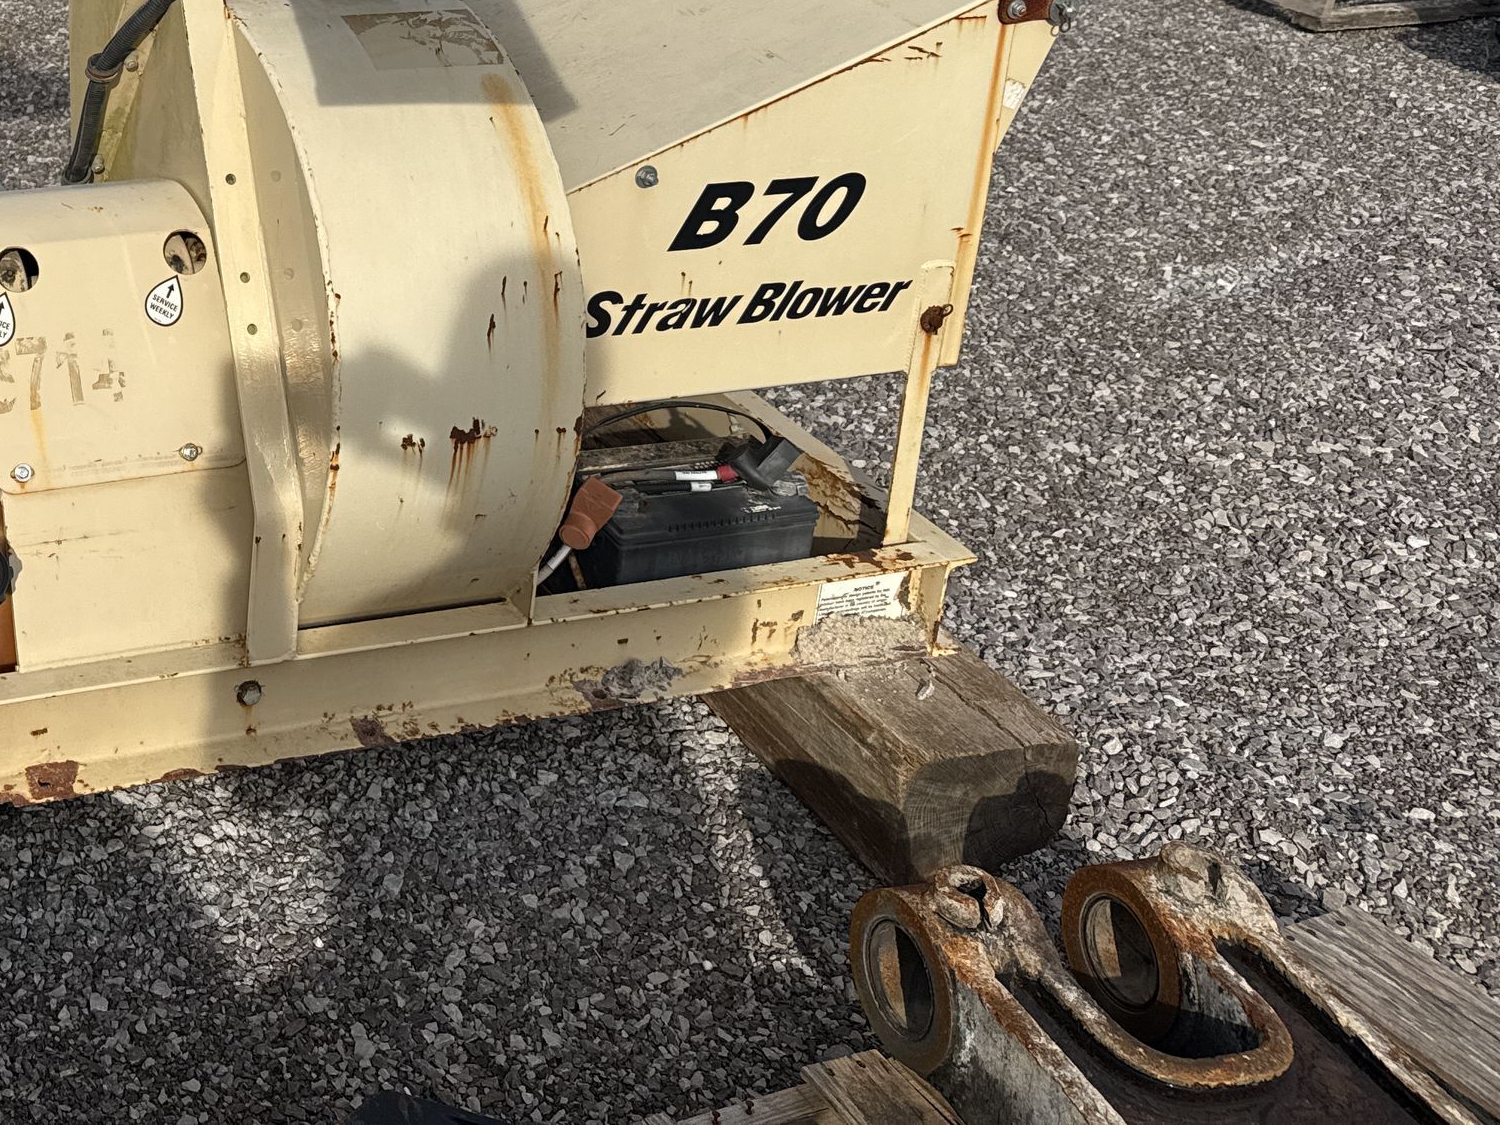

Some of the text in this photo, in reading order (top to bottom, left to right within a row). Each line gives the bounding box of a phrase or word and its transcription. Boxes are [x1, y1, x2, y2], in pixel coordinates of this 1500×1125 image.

[668, 172, 867, 252] B70
[150, 302, 175, 319] WEEKLY
[152, 294, 178, 312] SERVICE
[586, 277, 914, 338] Straw Blower
